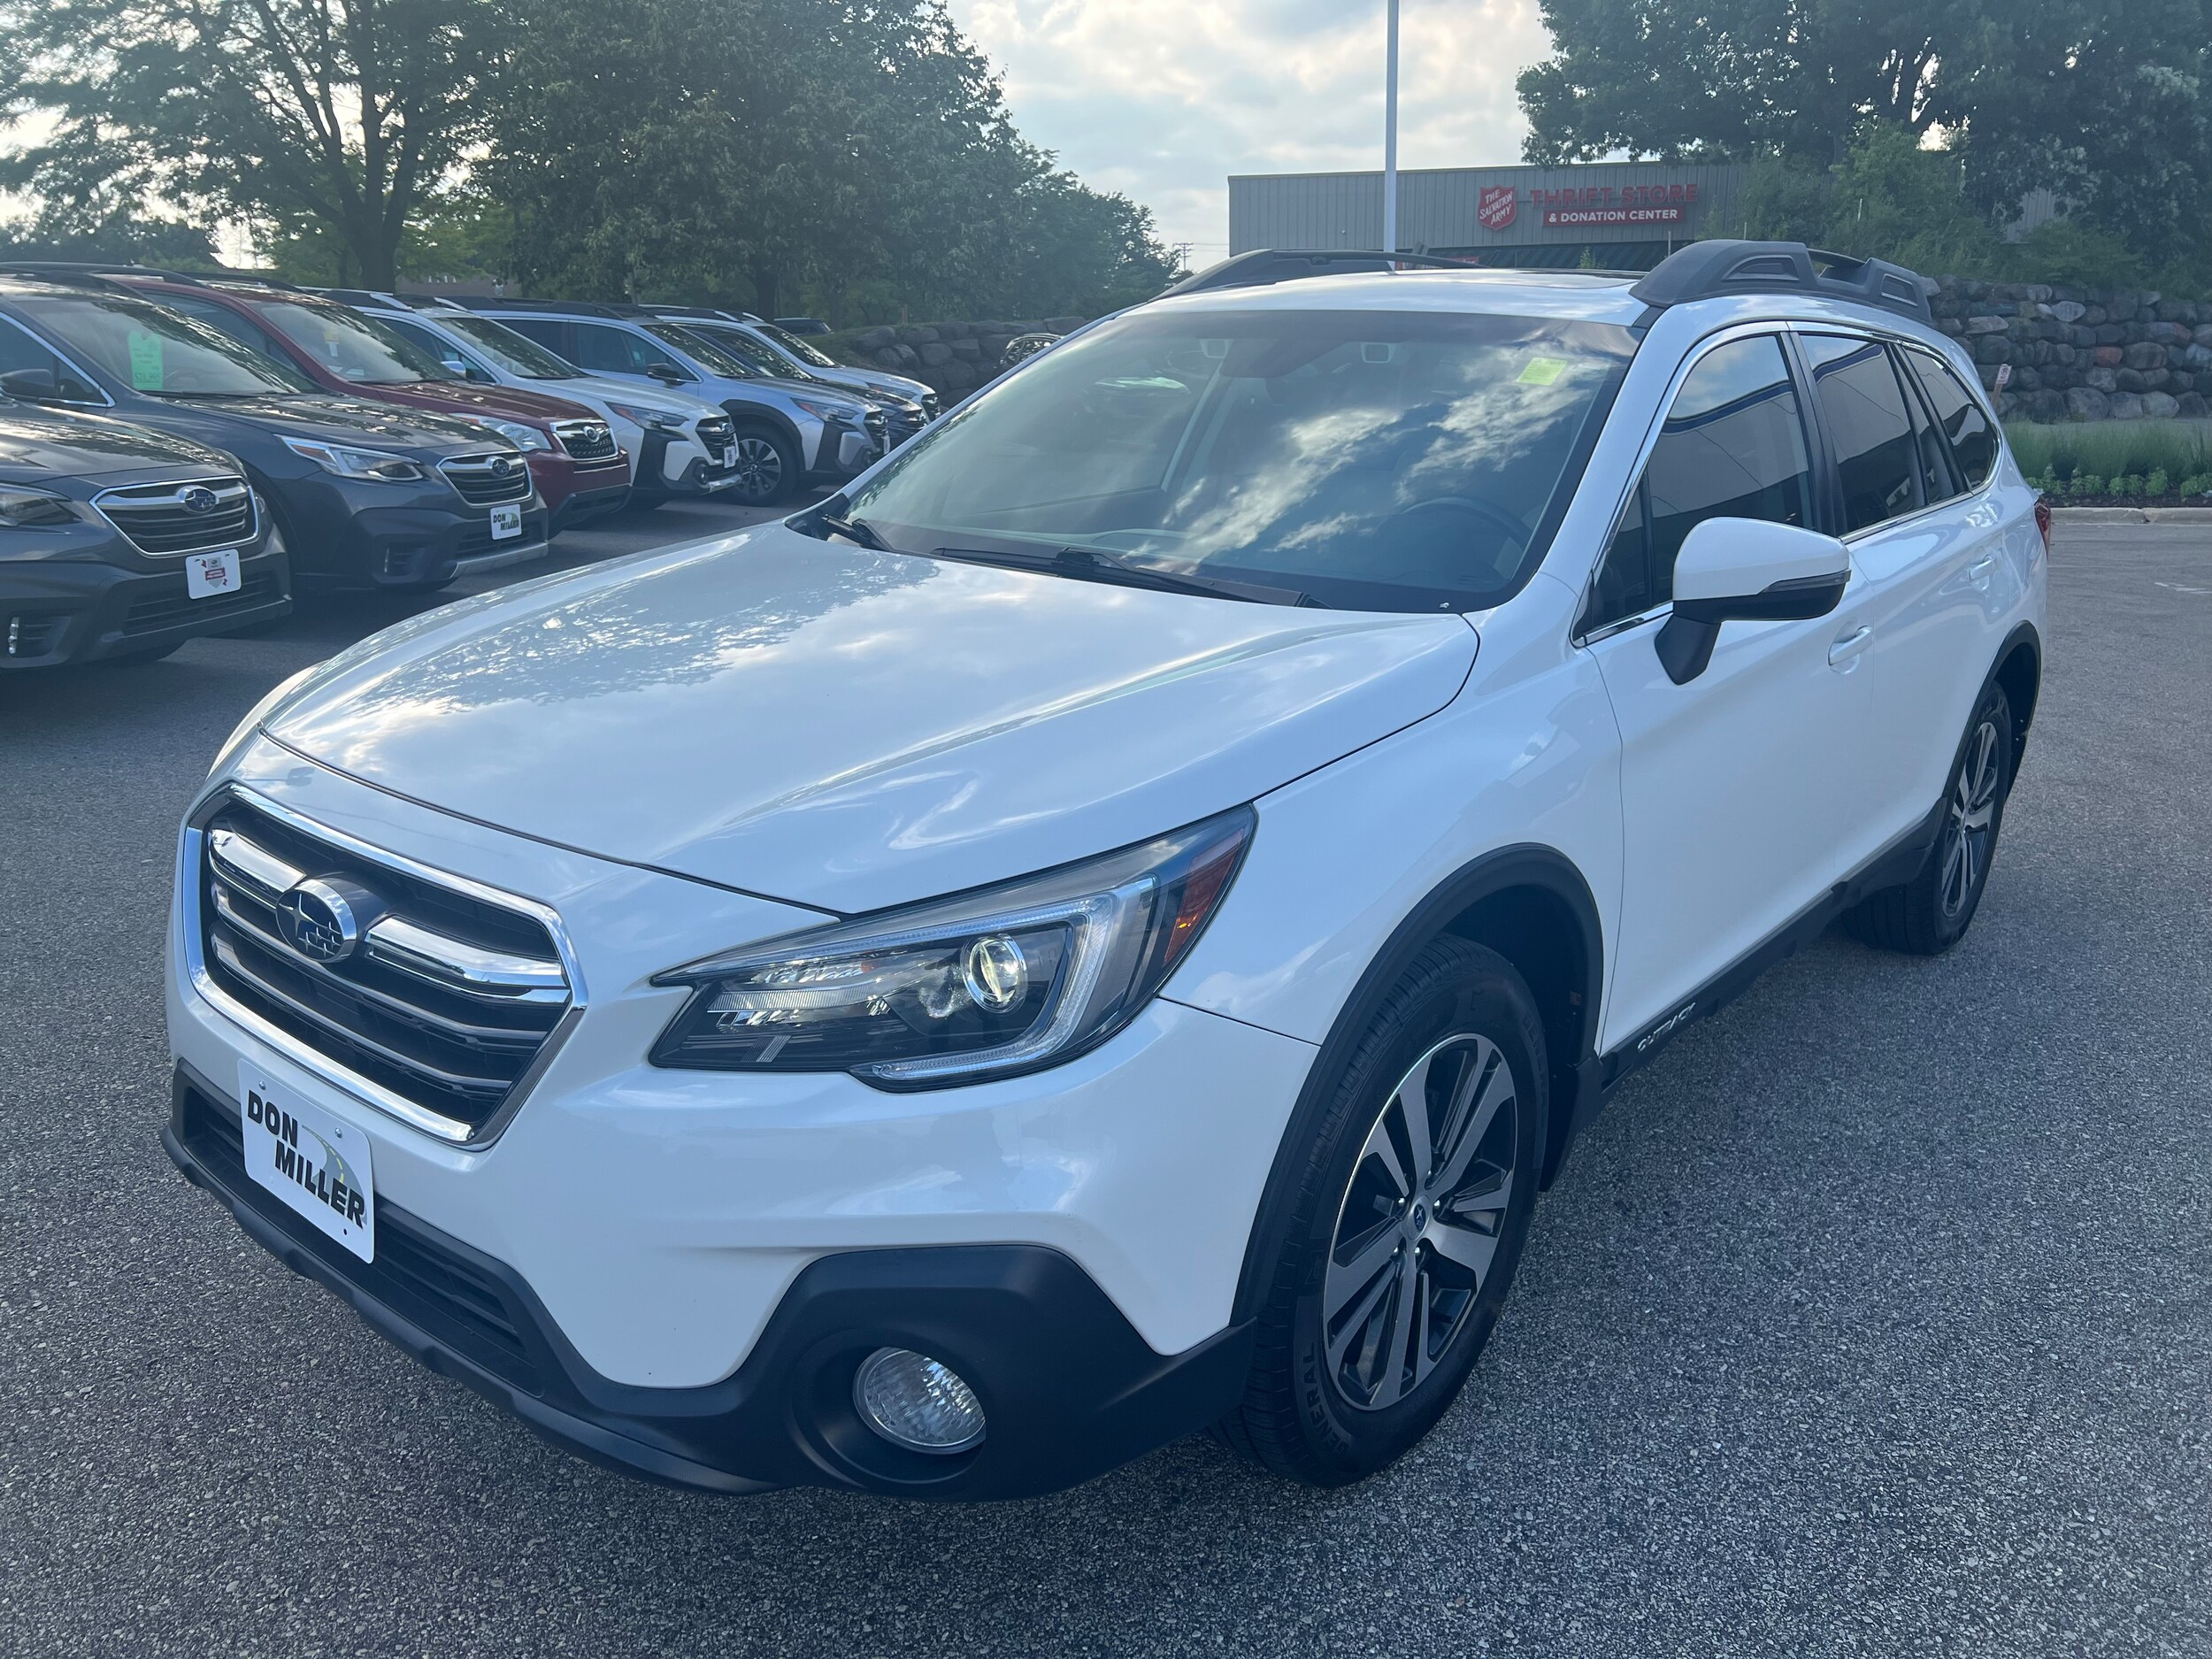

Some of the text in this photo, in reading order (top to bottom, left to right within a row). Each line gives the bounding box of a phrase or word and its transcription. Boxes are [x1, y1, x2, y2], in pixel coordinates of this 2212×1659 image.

[1479, 190, 1514, 220] SALVATION
[1485, 188, 1501, 204] THE
[1529, 183, 1699, 207] THRIFT STORE
[1490, 204, 1512, 226] ARMY
[1548, 209, 1678, 223] & DONATION CENTER
[493, 513, 506, 523] DON
[247, 1089, 298, 1148] DON
[274, 1139, 364, 1229] MILLER
